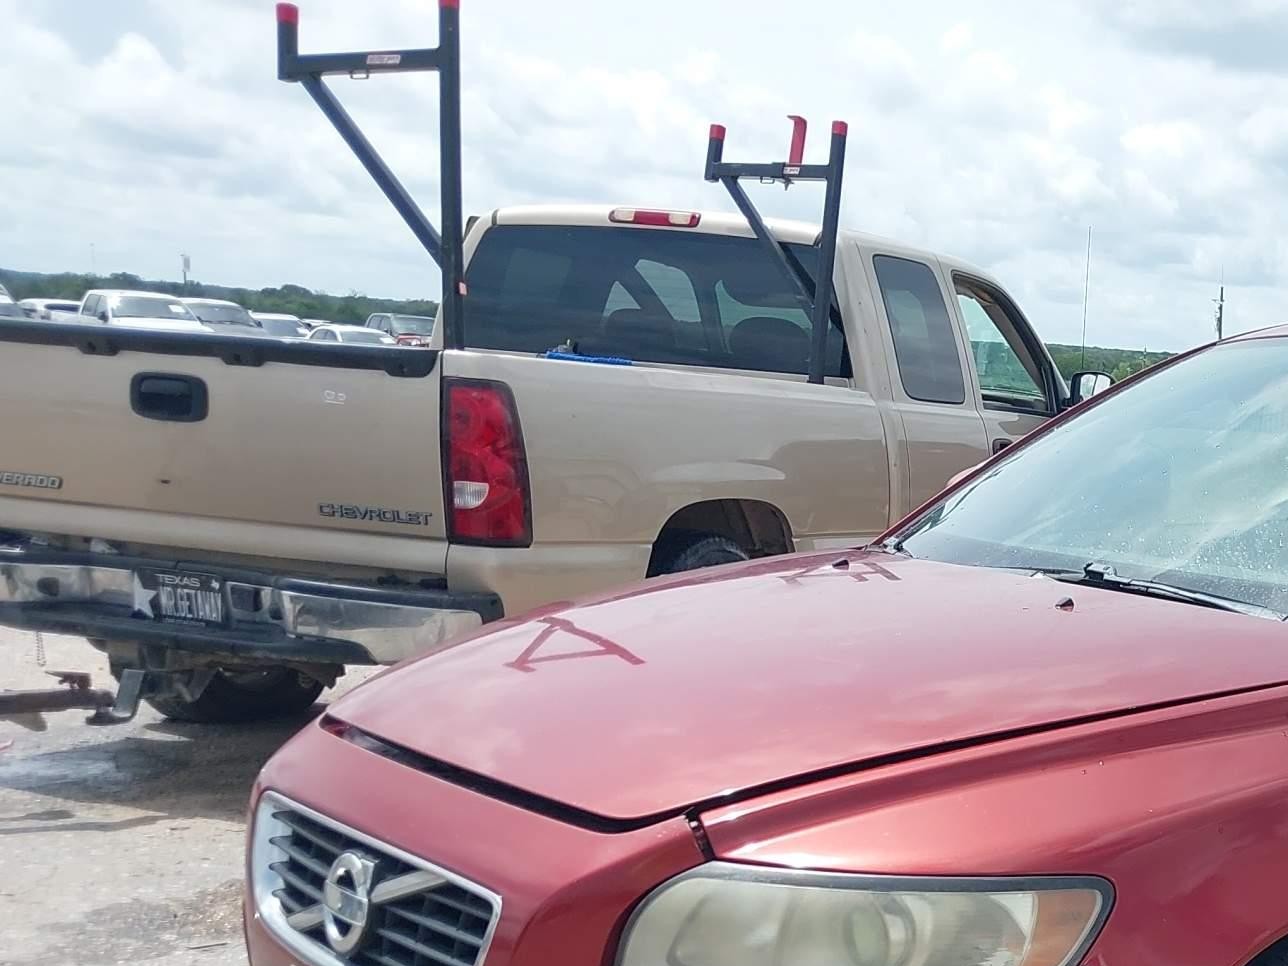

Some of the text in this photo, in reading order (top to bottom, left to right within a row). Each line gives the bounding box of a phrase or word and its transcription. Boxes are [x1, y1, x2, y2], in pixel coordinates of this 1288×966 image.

[0, 471, 61, 489] ERADO
[319, 502, 433, 526] CHEVROLET
[155, 573, 201, 587] TEXAS
